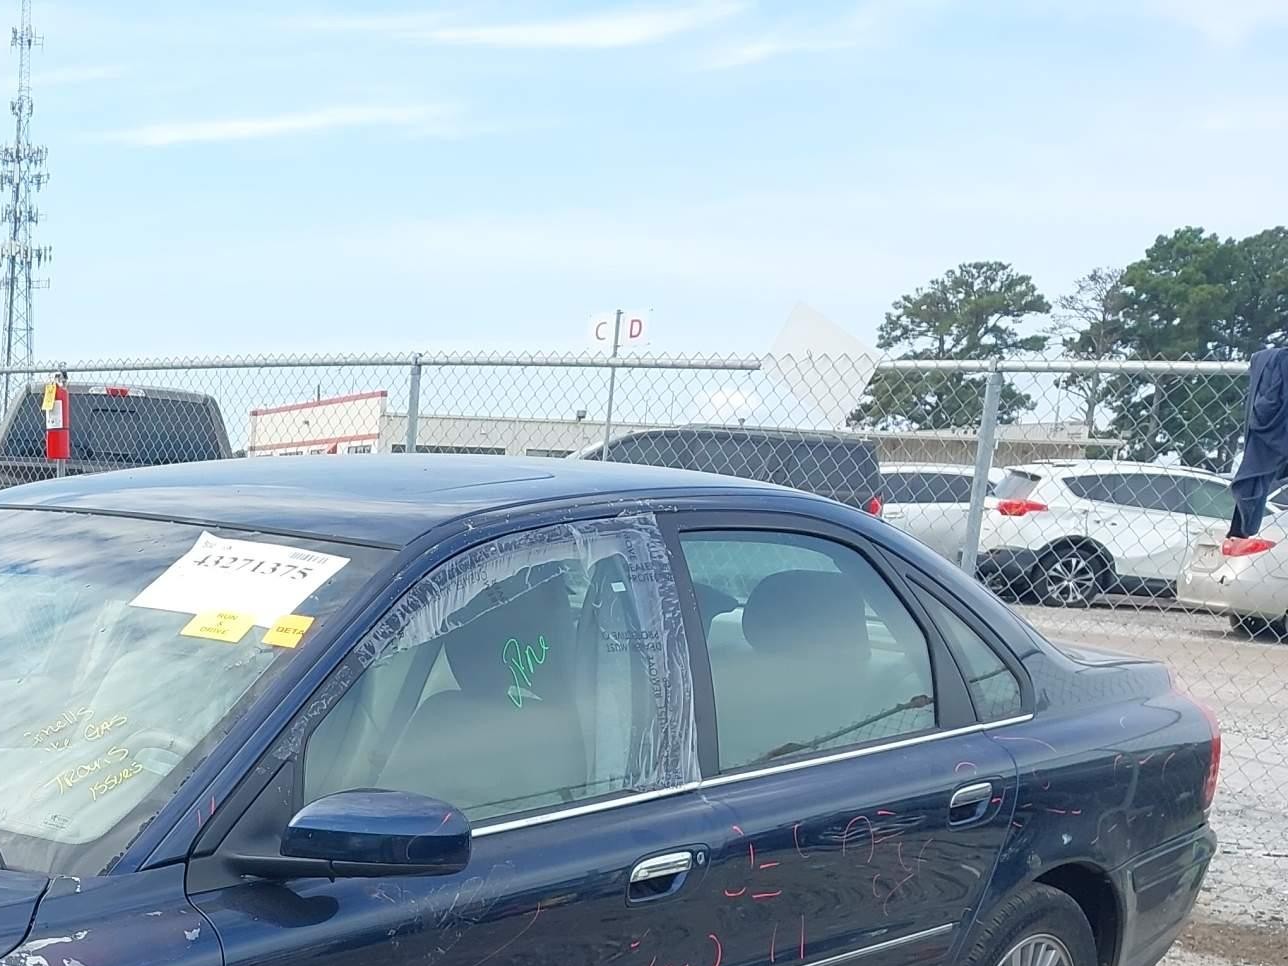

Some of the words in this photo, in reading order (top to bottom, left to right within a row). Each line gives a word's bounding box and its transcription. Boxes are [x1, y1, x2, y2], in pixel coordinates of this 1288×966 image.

[595, 321, 607, 340] C
[629, 319, 642, 338] D
[193, 554, 314, 580] 43271375
[216, 612, 239, 621] RUN
